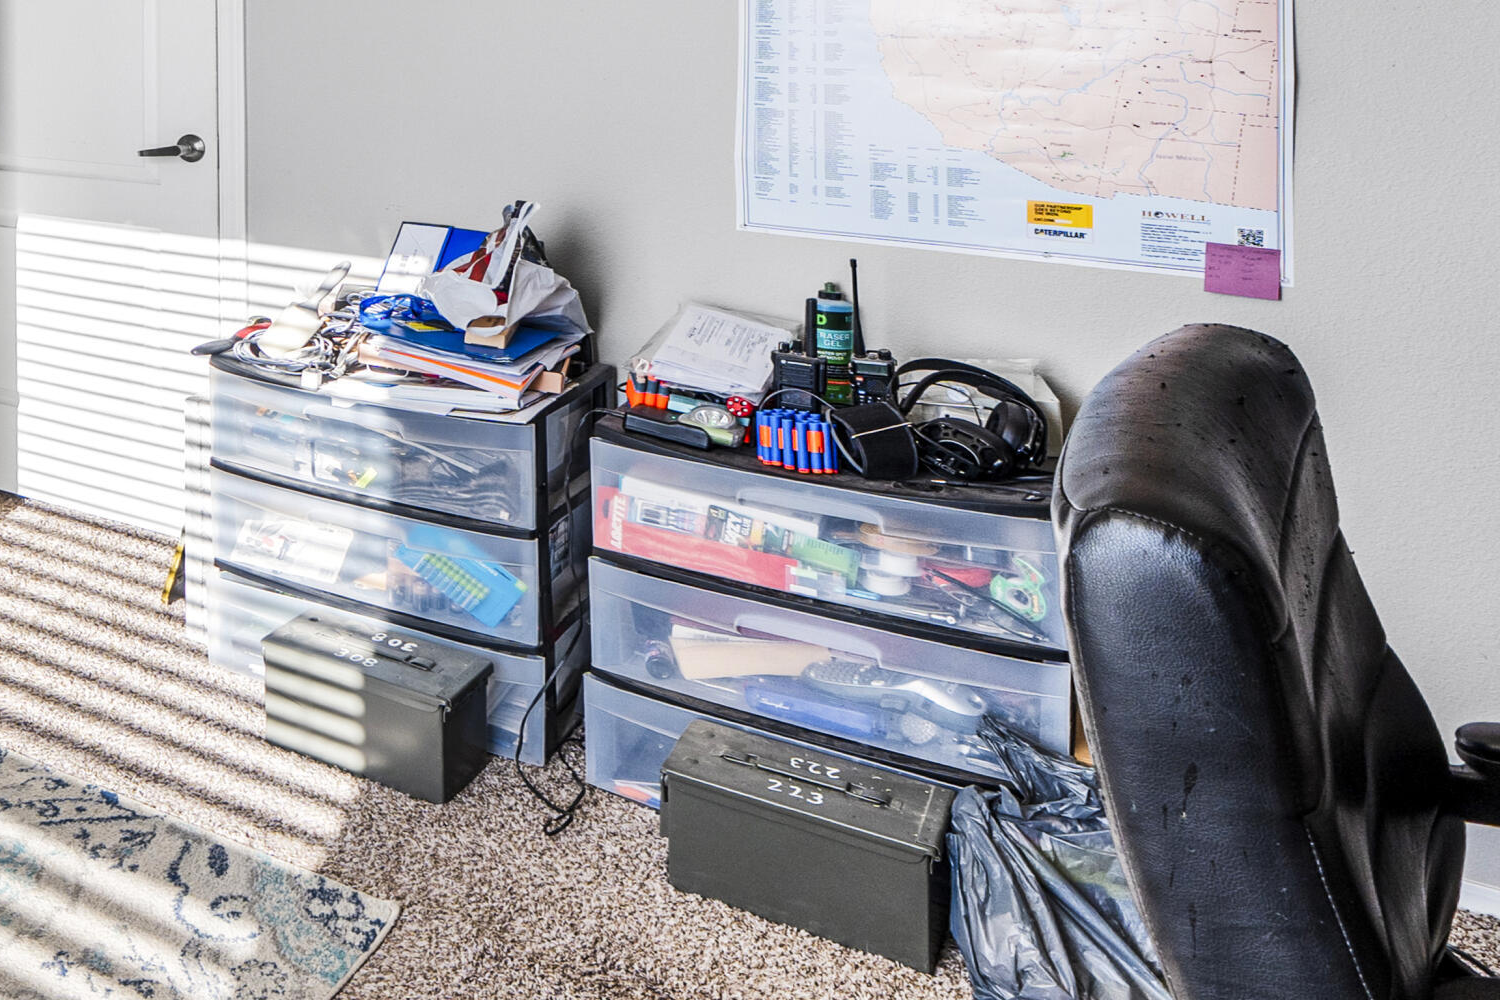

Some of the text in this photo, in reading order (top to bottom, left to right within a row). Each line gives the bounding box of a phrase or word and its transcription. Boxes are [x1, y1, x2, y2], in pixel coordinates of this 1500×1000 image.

[1034, 228, 1086, 239] CATERPILLAR
[818, 331, 850, 341] RASER
[371, 632, 419, 652] 308
[333, 648, 378, 667] 308
[790, 757, 841, 779] 223
[767, 778, 824, 805] 223
